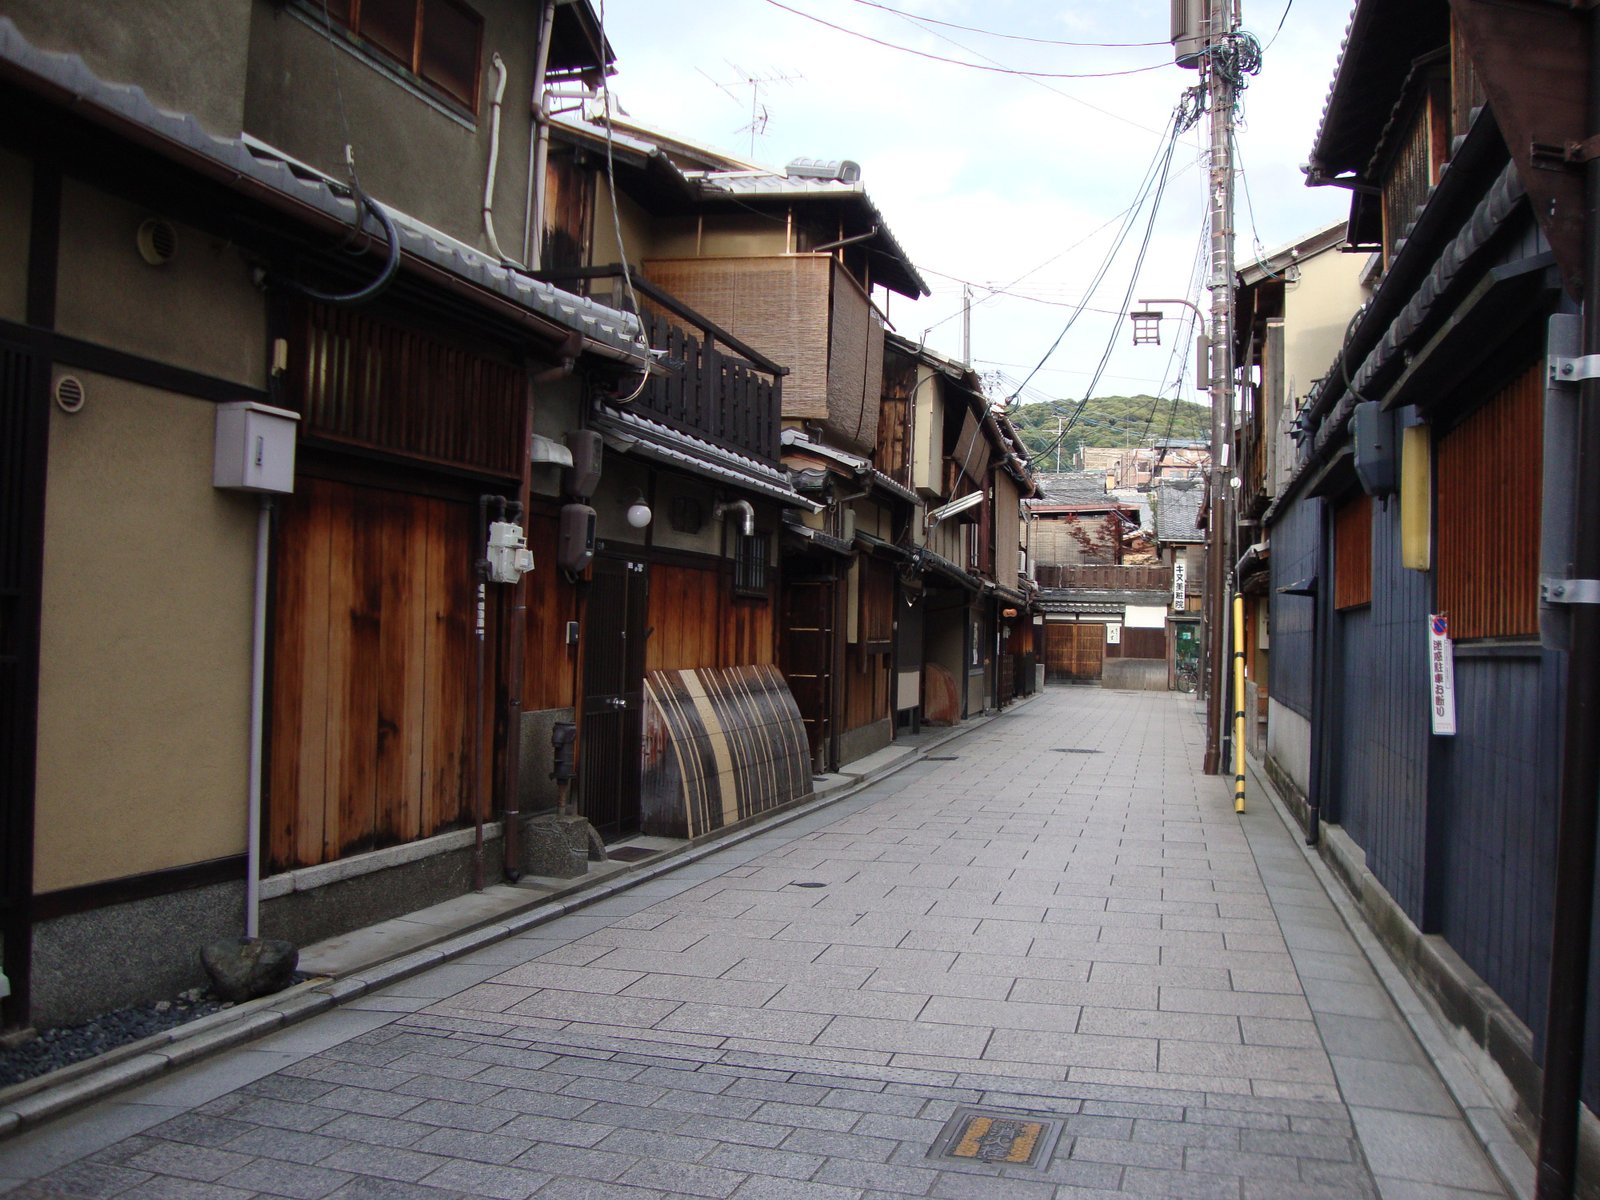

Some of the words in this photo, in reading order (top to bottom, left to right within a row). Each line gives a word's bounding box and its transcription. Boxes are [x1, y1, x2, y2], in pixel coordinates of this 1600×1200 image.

[1433, 640, 1445, 717] 迷惑駐車お断り
